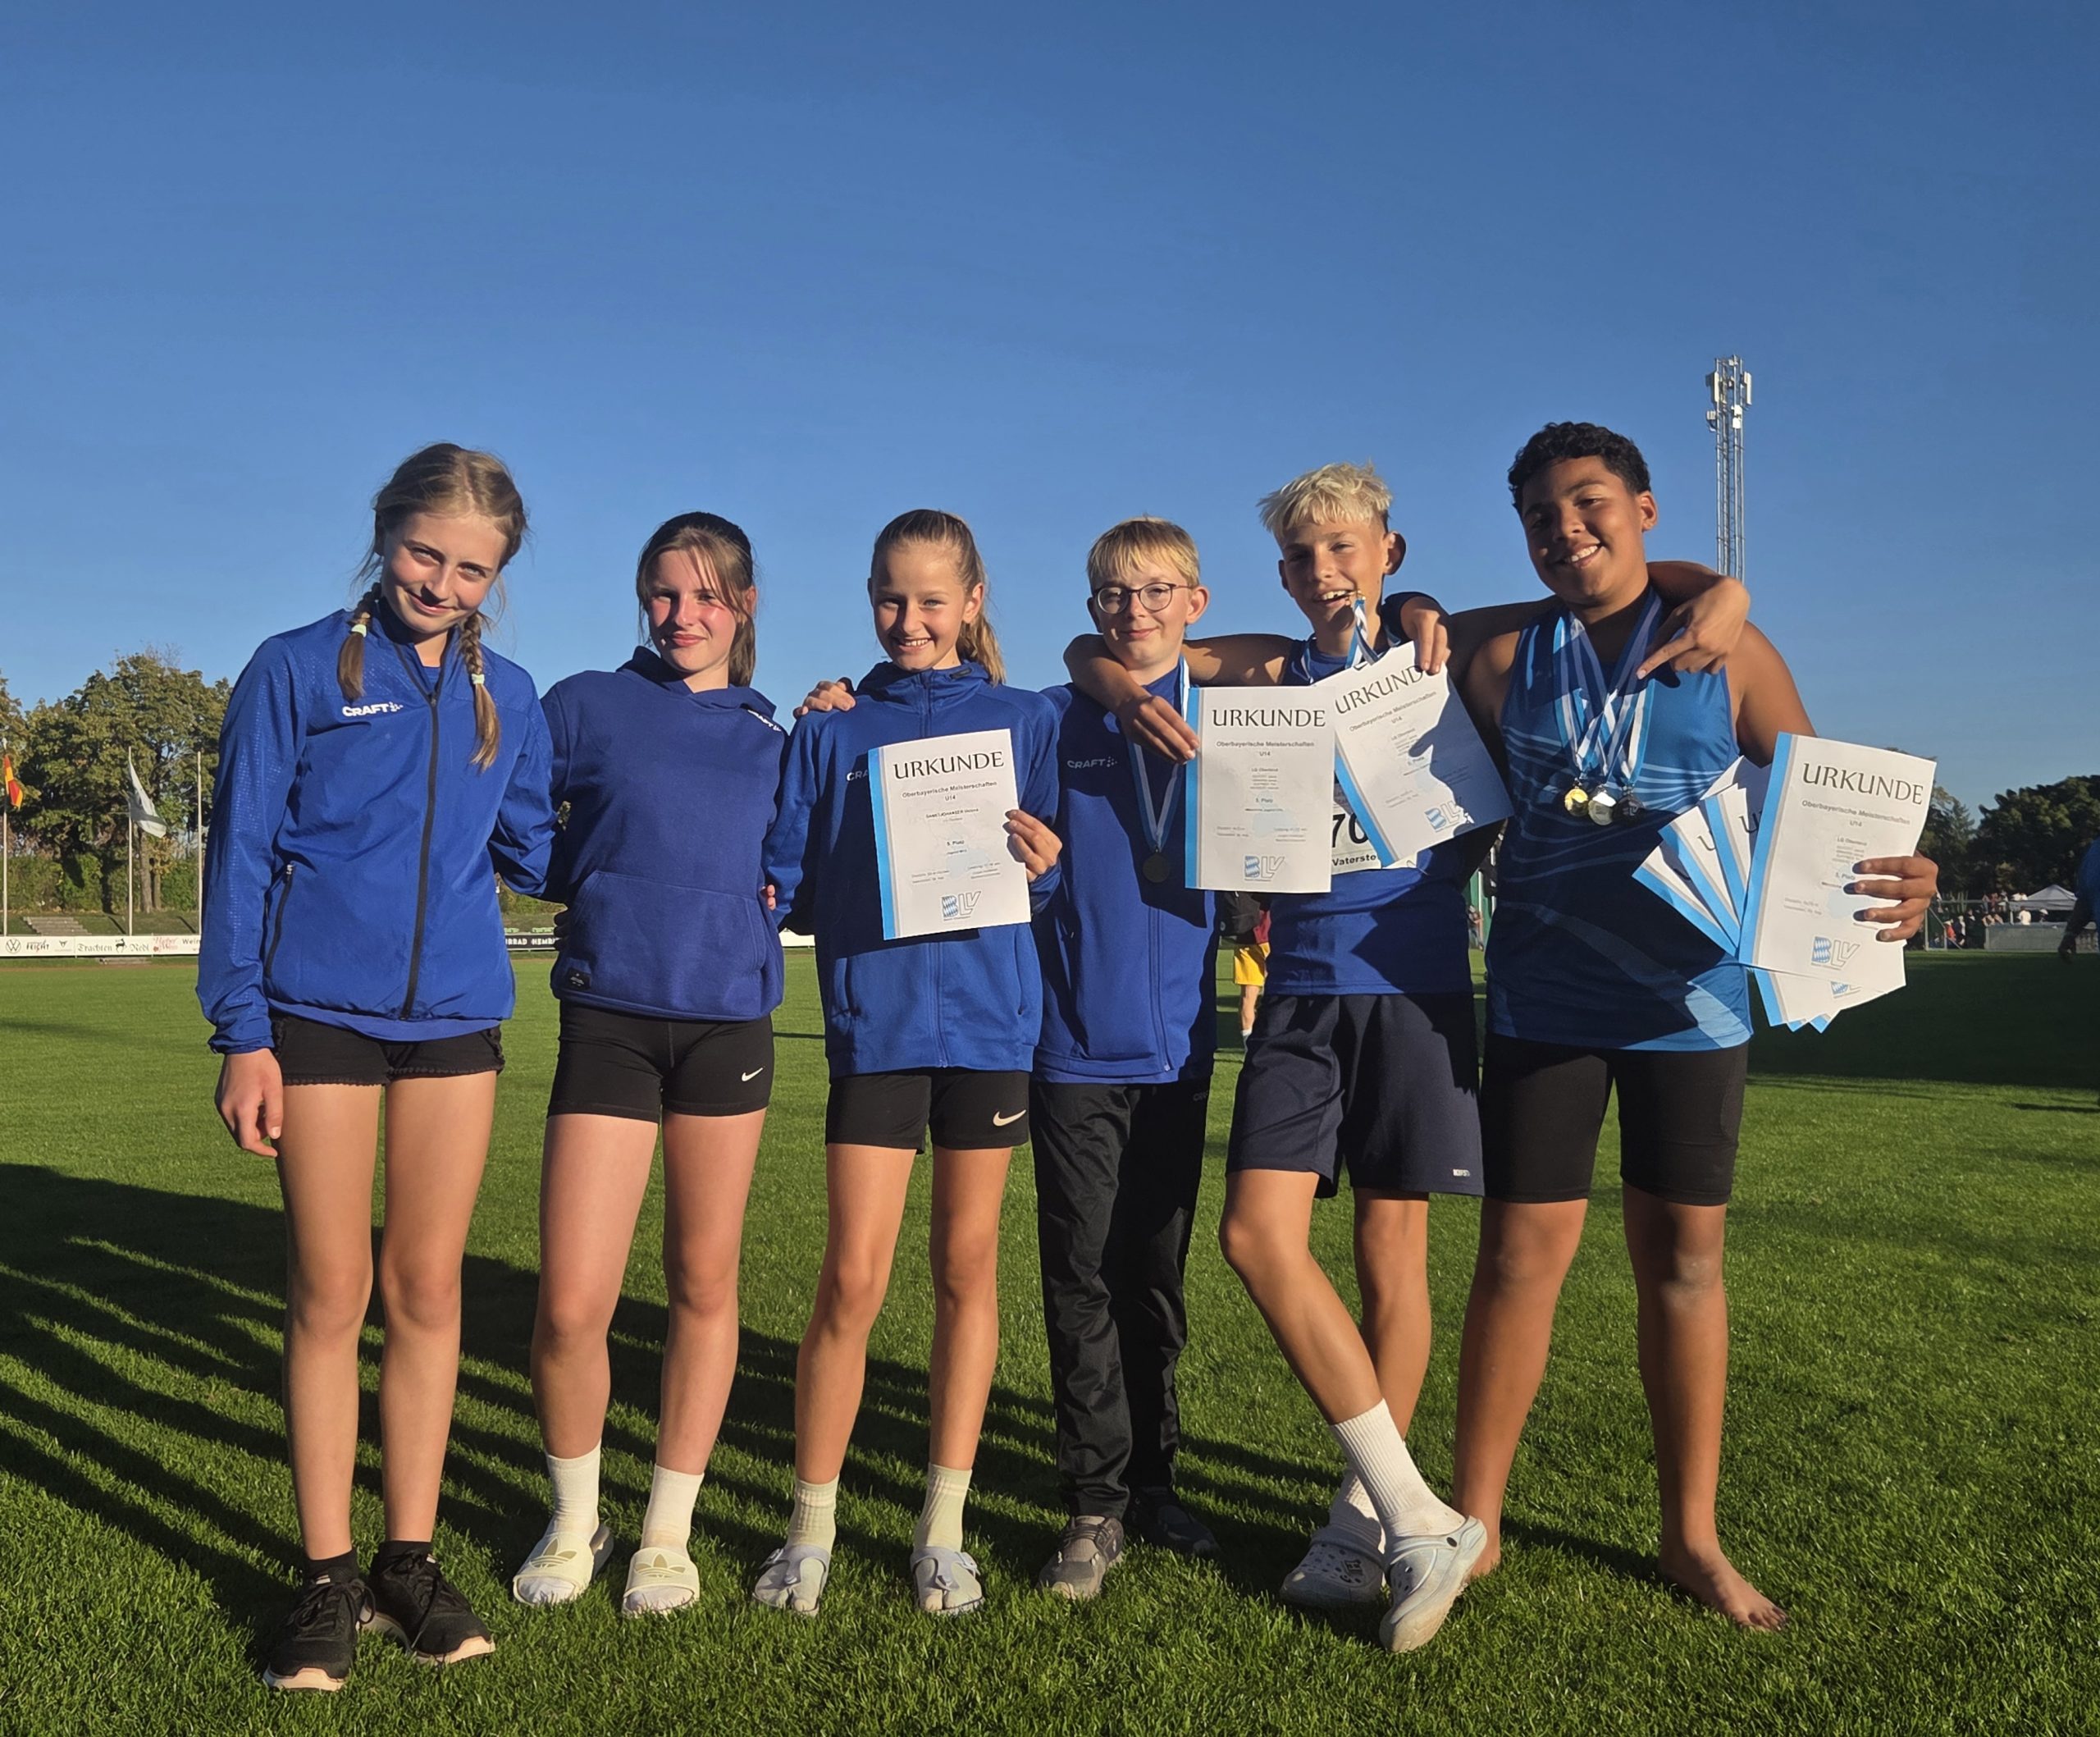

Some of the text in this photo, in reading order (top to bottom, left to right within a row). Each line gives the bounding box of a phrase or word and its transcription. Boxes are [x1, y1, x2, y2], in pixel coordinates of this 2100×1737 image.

[1335, 665, 1424, 715] URKUND
[342, 702, 389, 716] CRAFT
[1212, 709, 1326, 727] URKUNDE
[892, 751, 1004, 779] URKUNDE
[1067, 758, 1106, 769] CRAFT
[847, 770, 869, 781] CRA
[1801, 762, 1924, 805] URKUNDE
[902, 788, 948, 798] Oberbayerische
[1244, 856, 1285, 879] BLV
[1332, 854, 1376, 866] Vaterst
[942, 890, 981, 917] BLV
[1811, 935, 1860, 968] BLV
